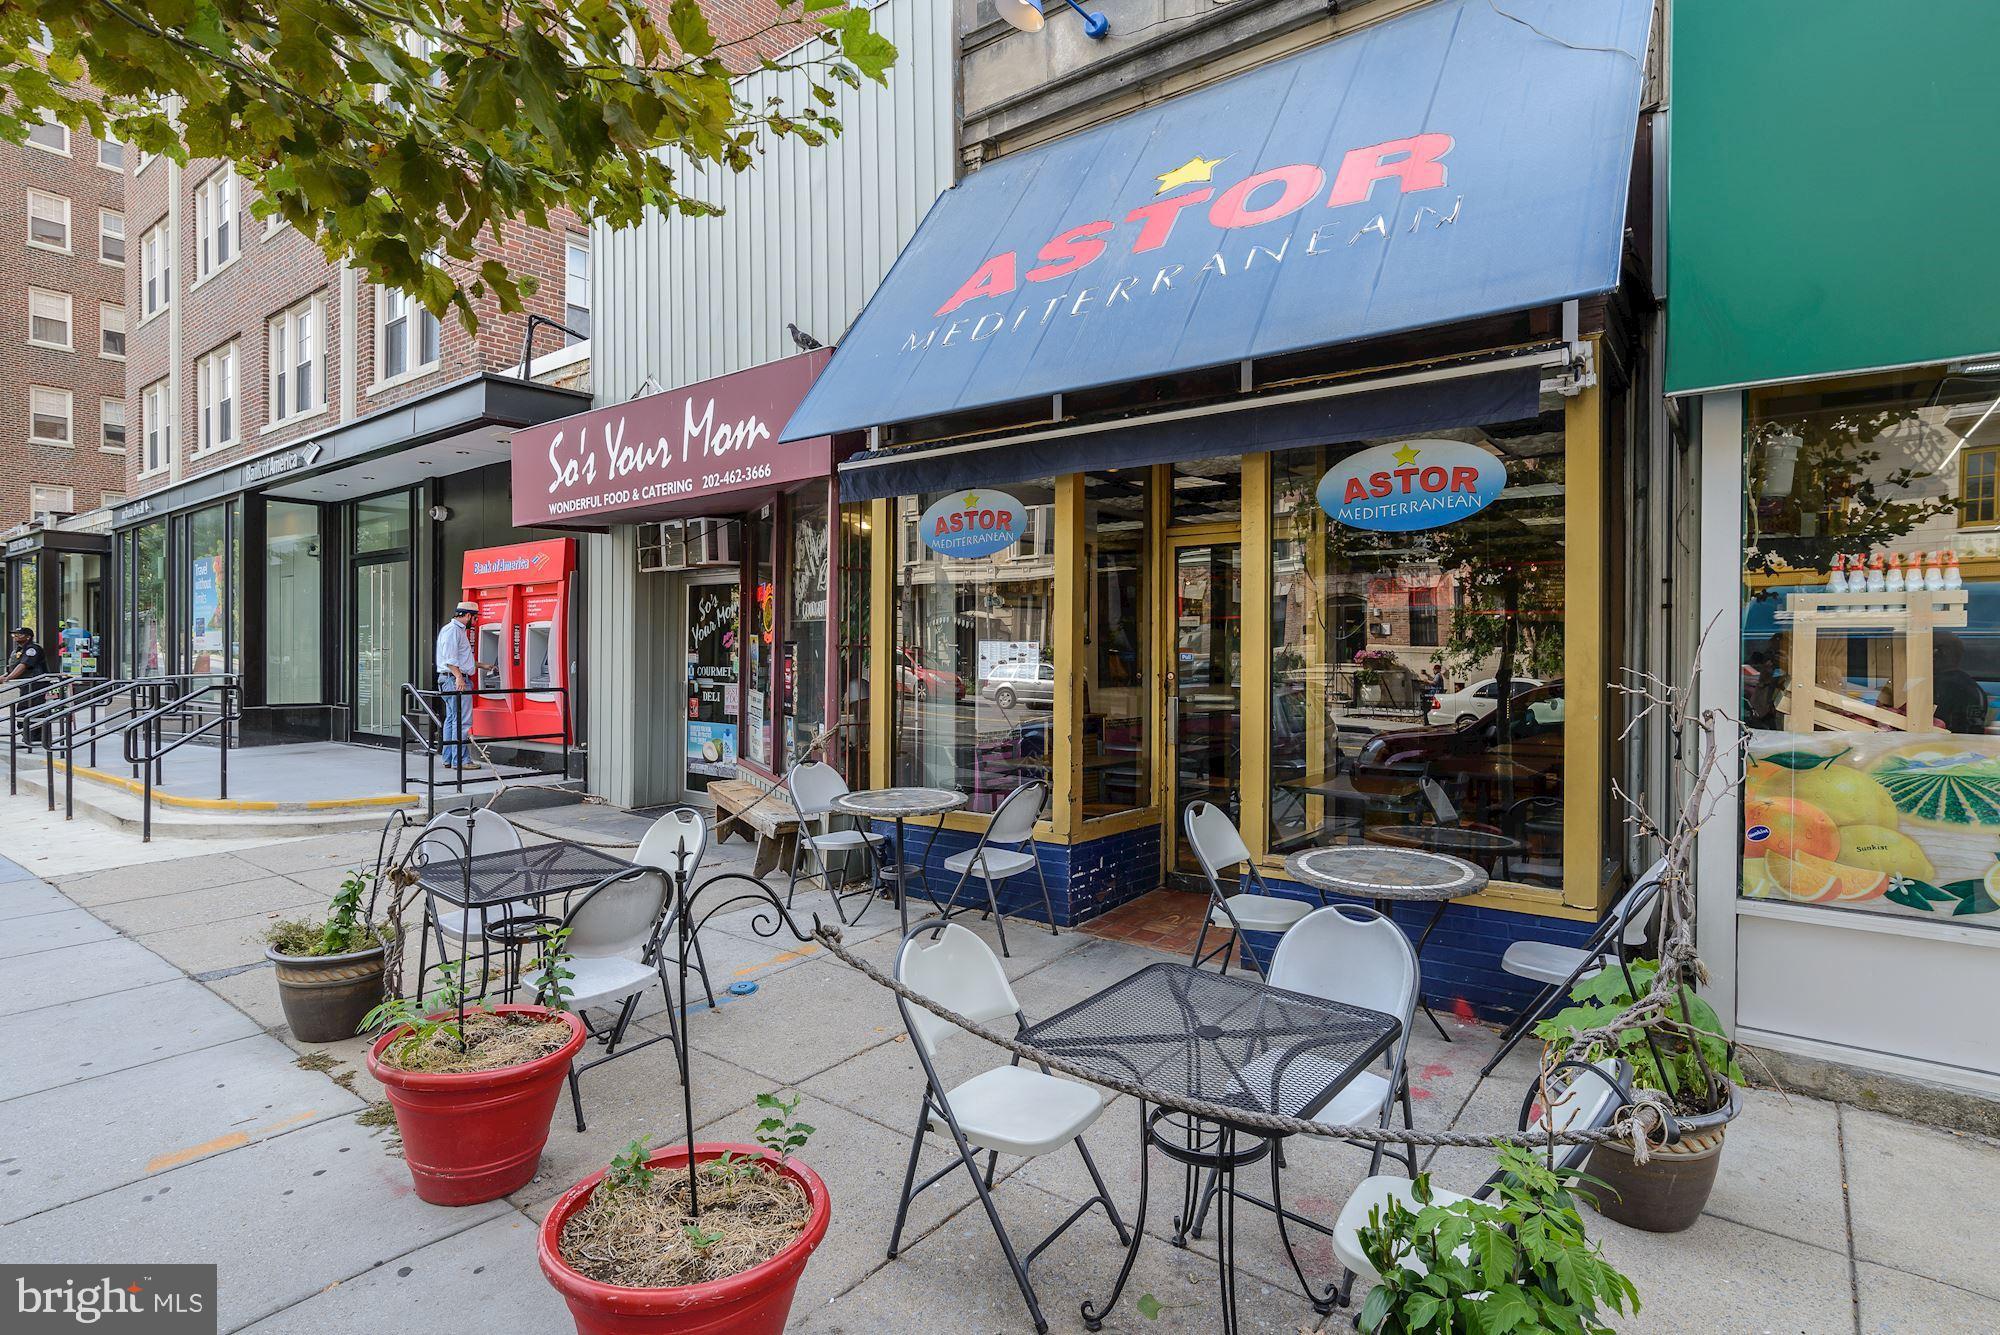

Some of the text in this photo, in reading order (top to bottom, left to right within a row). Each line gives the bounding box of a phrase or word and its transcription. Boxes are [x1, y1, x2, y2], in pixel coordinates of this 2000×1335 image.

[934, 133, 1456, 317] ASTOR
[899, 195, 1464, 354] MEDITERRANEAN
[549, 397, 770, 493] So's Your Mom
[269, 450, 298, 475] America
[548, 463, 772, 515] WONDERFUL FOOD & CATERING 202-462-3666
[1344, 466, 1479, 505] ASTOR
[1338, 495, 1482, 521] MEDITERRANEAN
[934, 509, 1013, 537] ASTOR
[931, 531, 1015, 549] MEDITERRANEAN
[473, 556, 530, 575] Bank of America
[691, 621, 717, 649] Your
[703, 691, 721, 702] DELI
[1856, 844, 1889, 853] Sunkist
